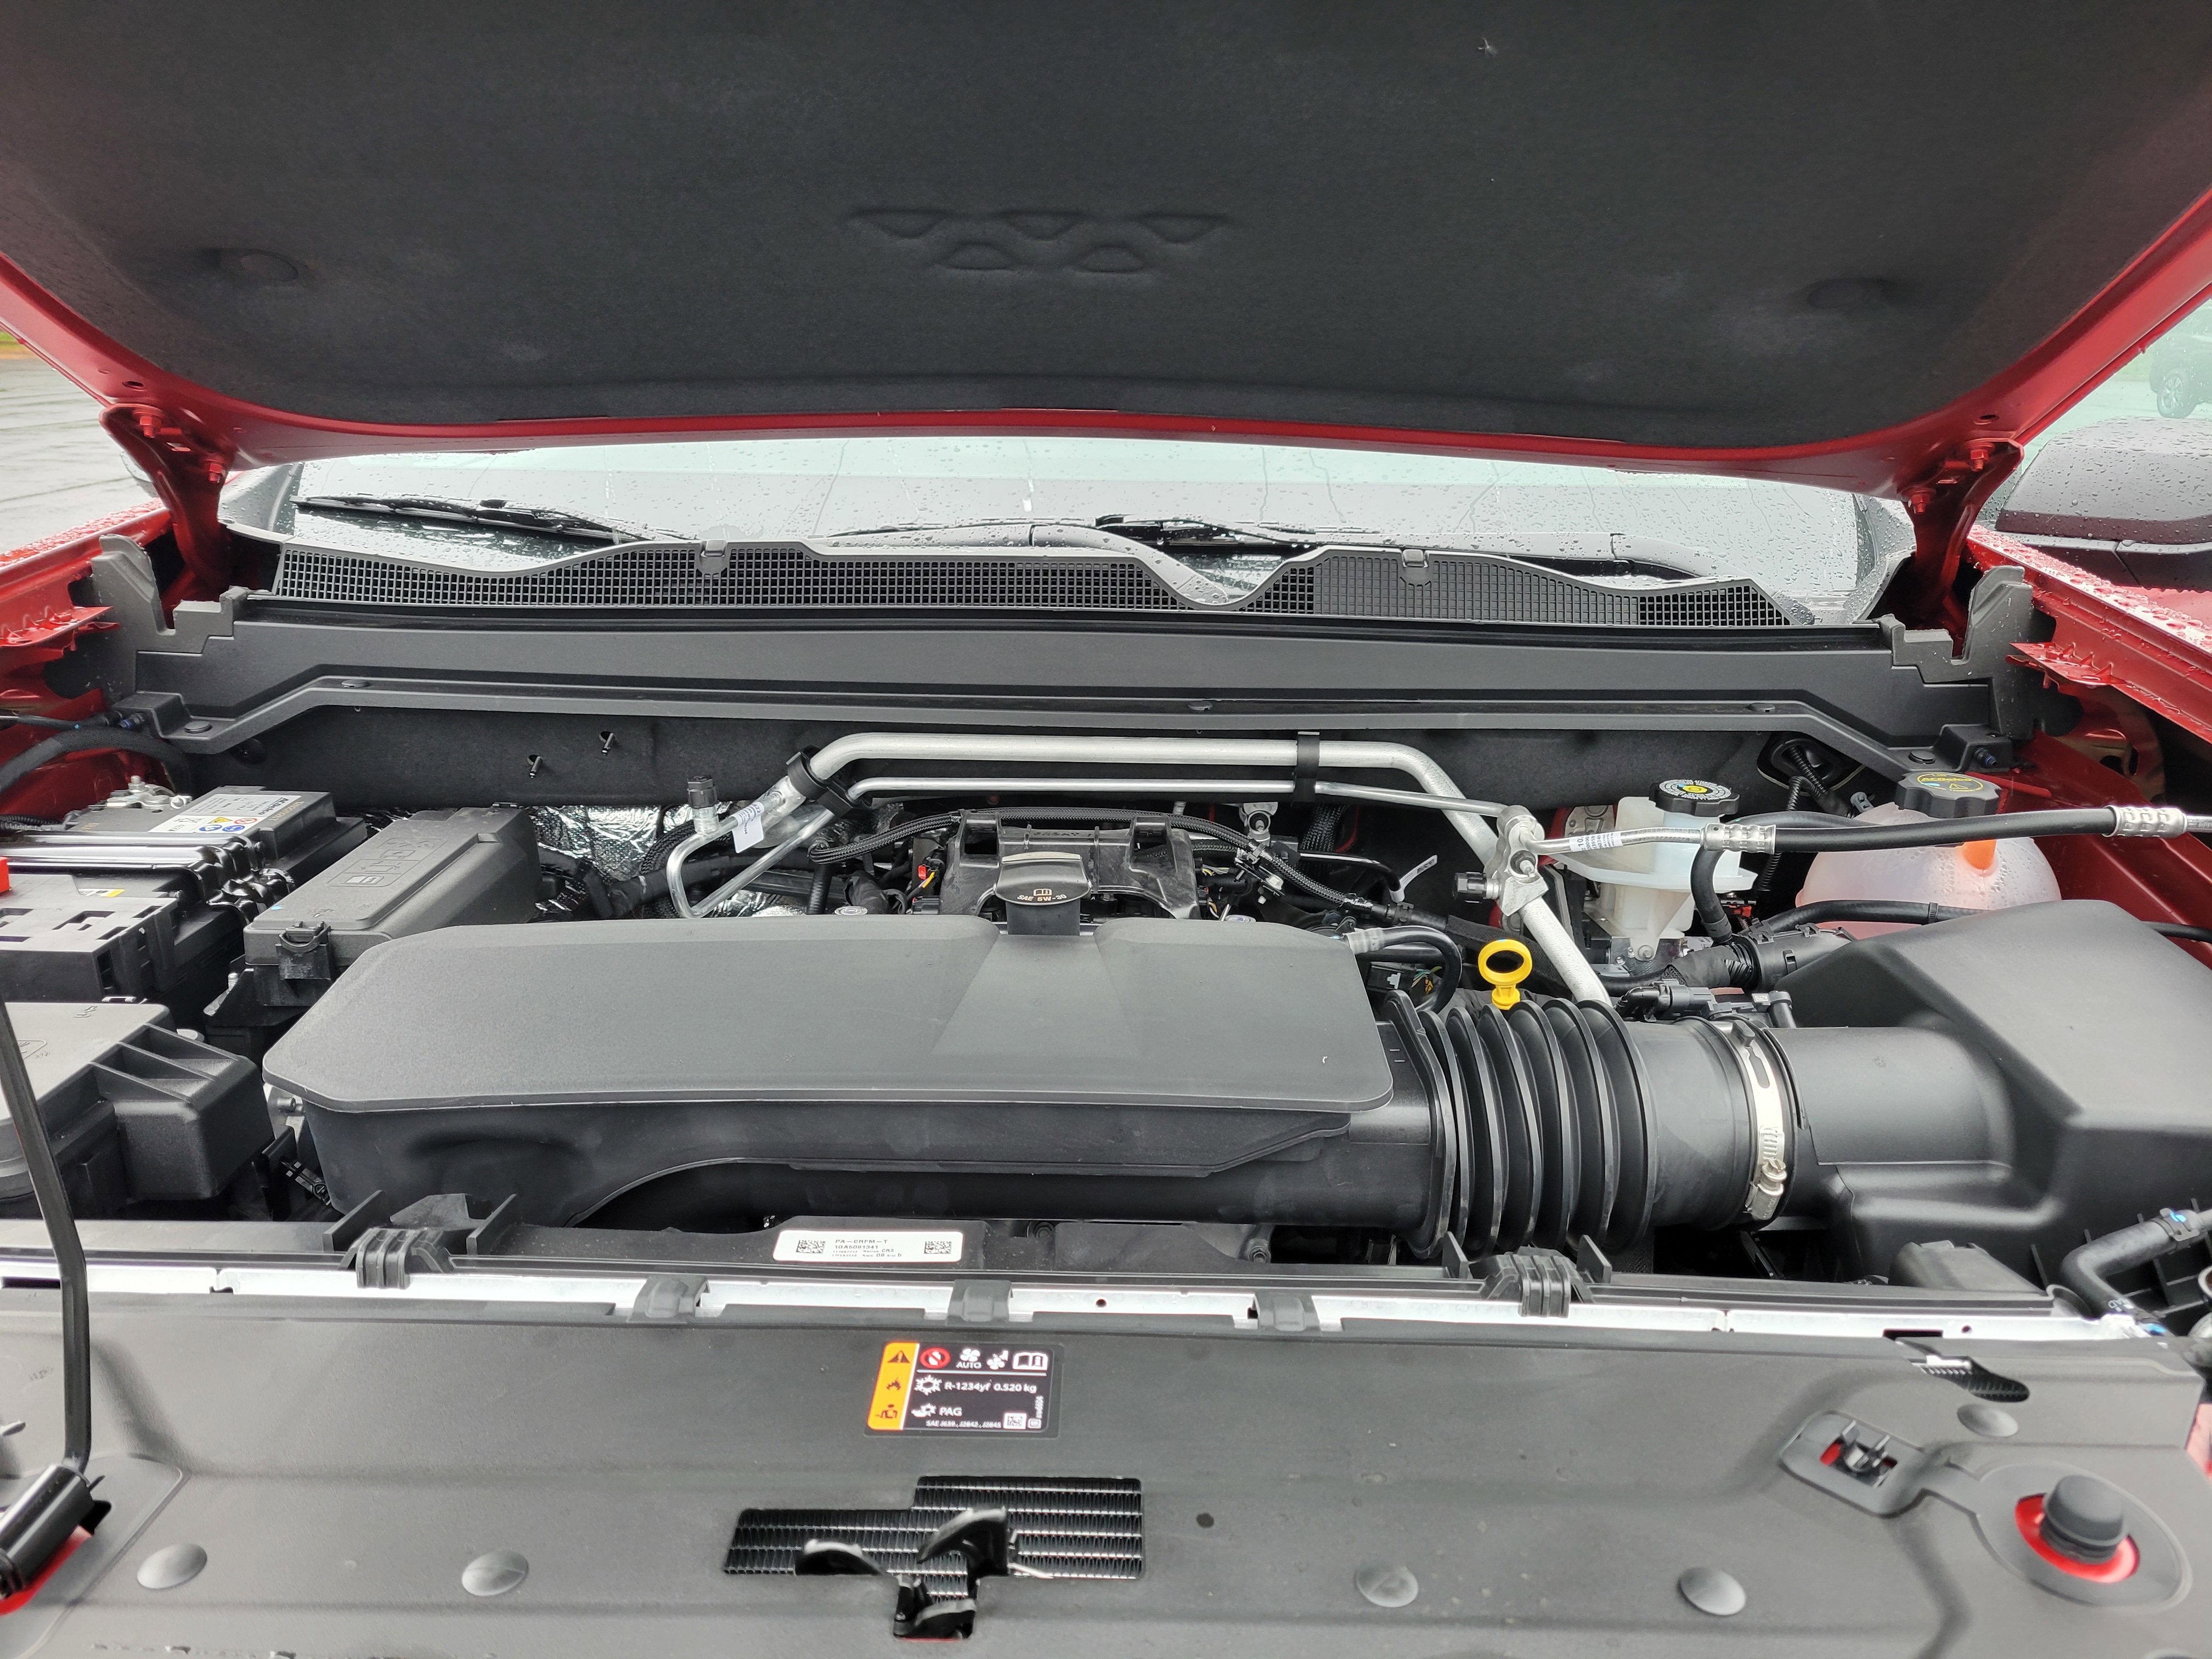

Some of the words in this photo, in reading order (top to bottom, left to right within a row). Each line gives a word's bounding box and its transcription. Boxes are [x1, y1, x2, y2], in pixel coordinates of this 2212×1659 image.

[258, 798, 289, 815] ACDelco
[944, 1381, 991, 1392] R-1234yf
[993, 1383, 1022, 1392] 0.520
[1023, 1383, 1037, 1393] kg
[939, 1406, 962, 1417] PAG
